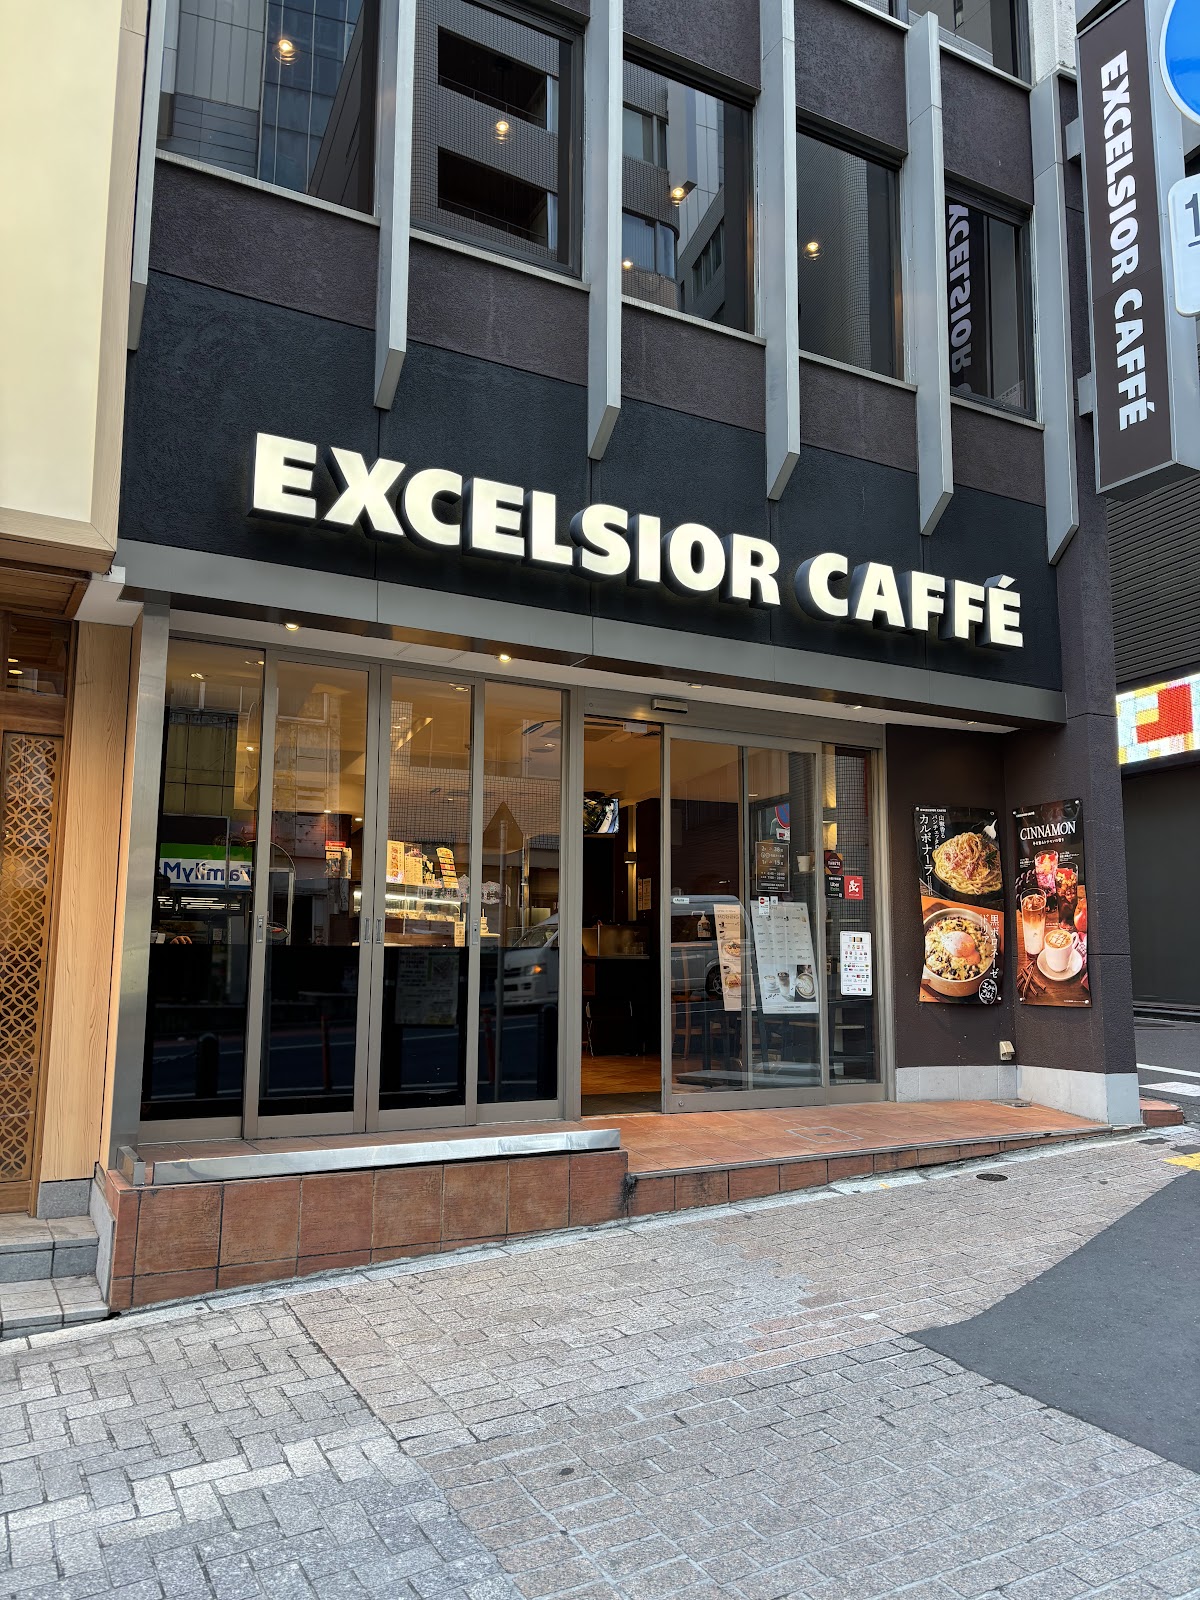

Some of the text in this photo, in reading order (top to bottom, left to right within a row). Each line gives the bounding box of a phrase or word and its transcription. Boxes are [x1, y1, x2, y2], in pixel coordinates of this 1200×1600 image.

[1100, 50, 1155, 431] EXCELSIOR CAFFÉ
[250, 432, 1024, 649] EXCELSIOR CAFFÉ
[919, 814, 934, 876] カルボナーラ
[1019, 820, 1077, 841] CINNAMON
[981, 914, 990, 945] ドリア
[989, 914, 1000, 979] 黒ボロネーゼ
